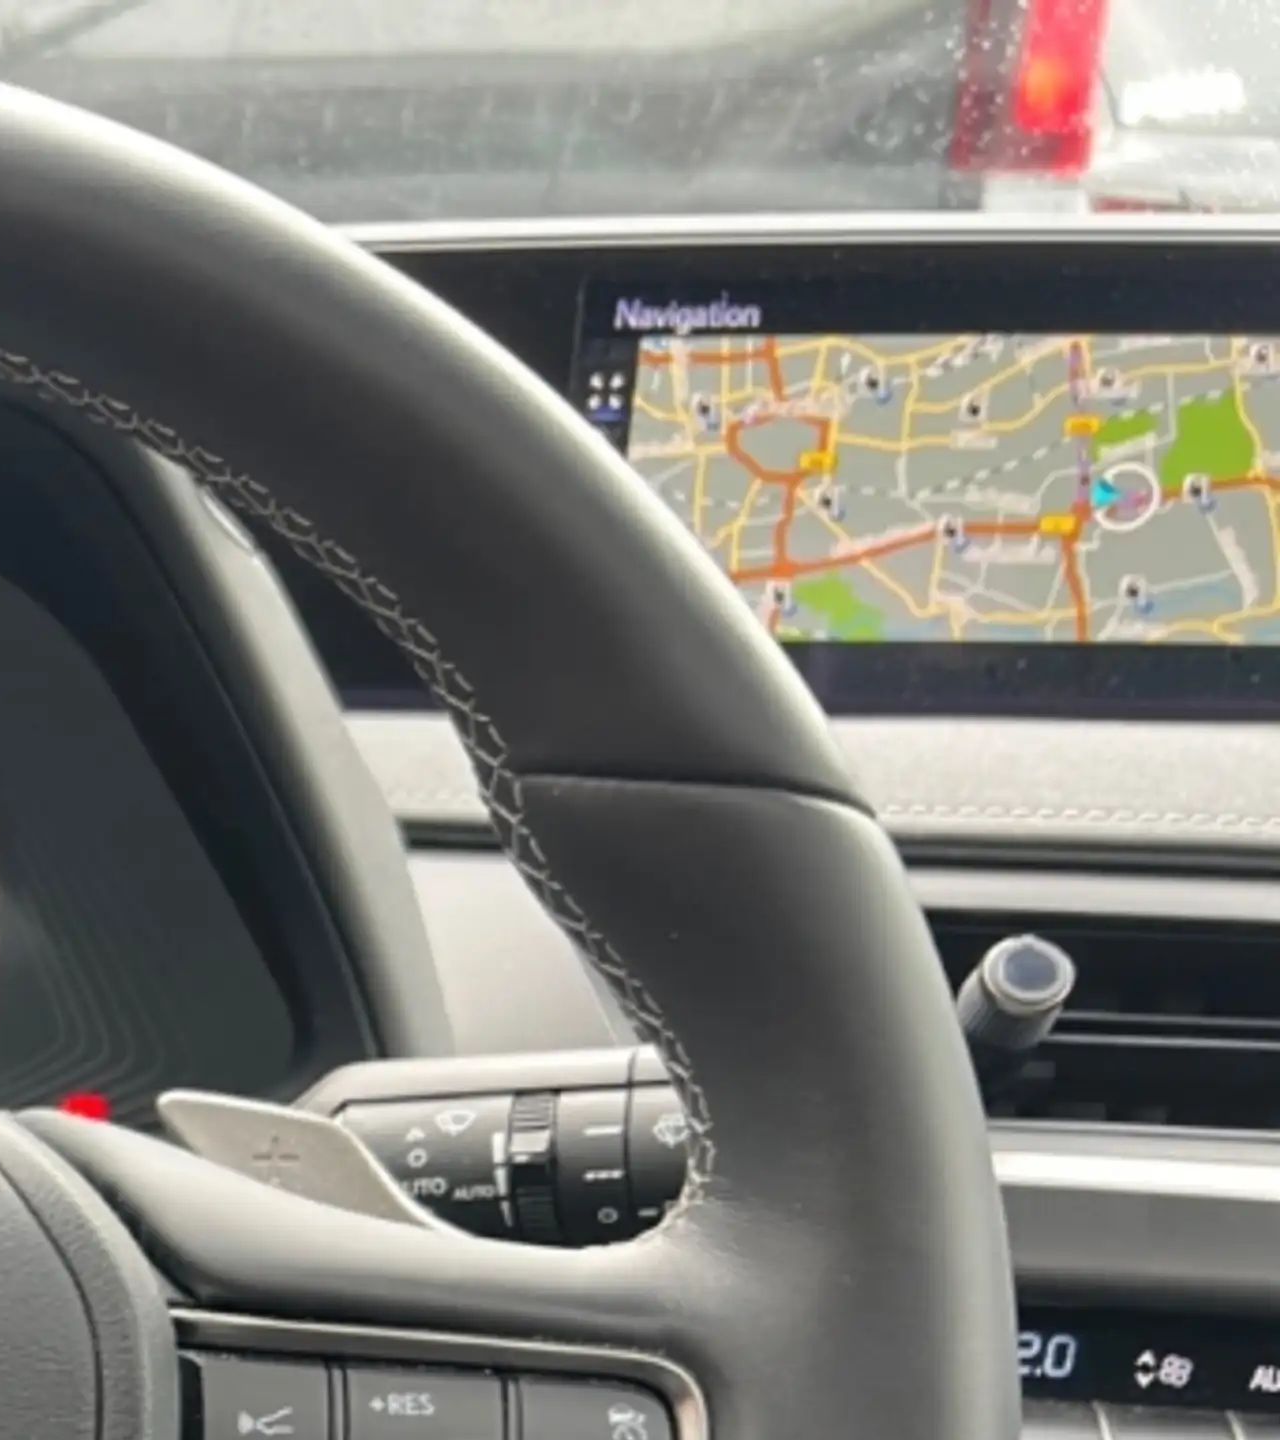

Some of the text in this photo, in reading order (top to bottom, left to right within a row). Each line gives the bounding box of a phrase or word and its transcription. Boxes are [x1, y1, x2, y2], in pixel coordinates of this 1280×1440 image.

[613, 298, 761, 334] Navigation
[396, 1177, 448, 1197] UTO
[451, 1184, 496, 1202] AUTO
